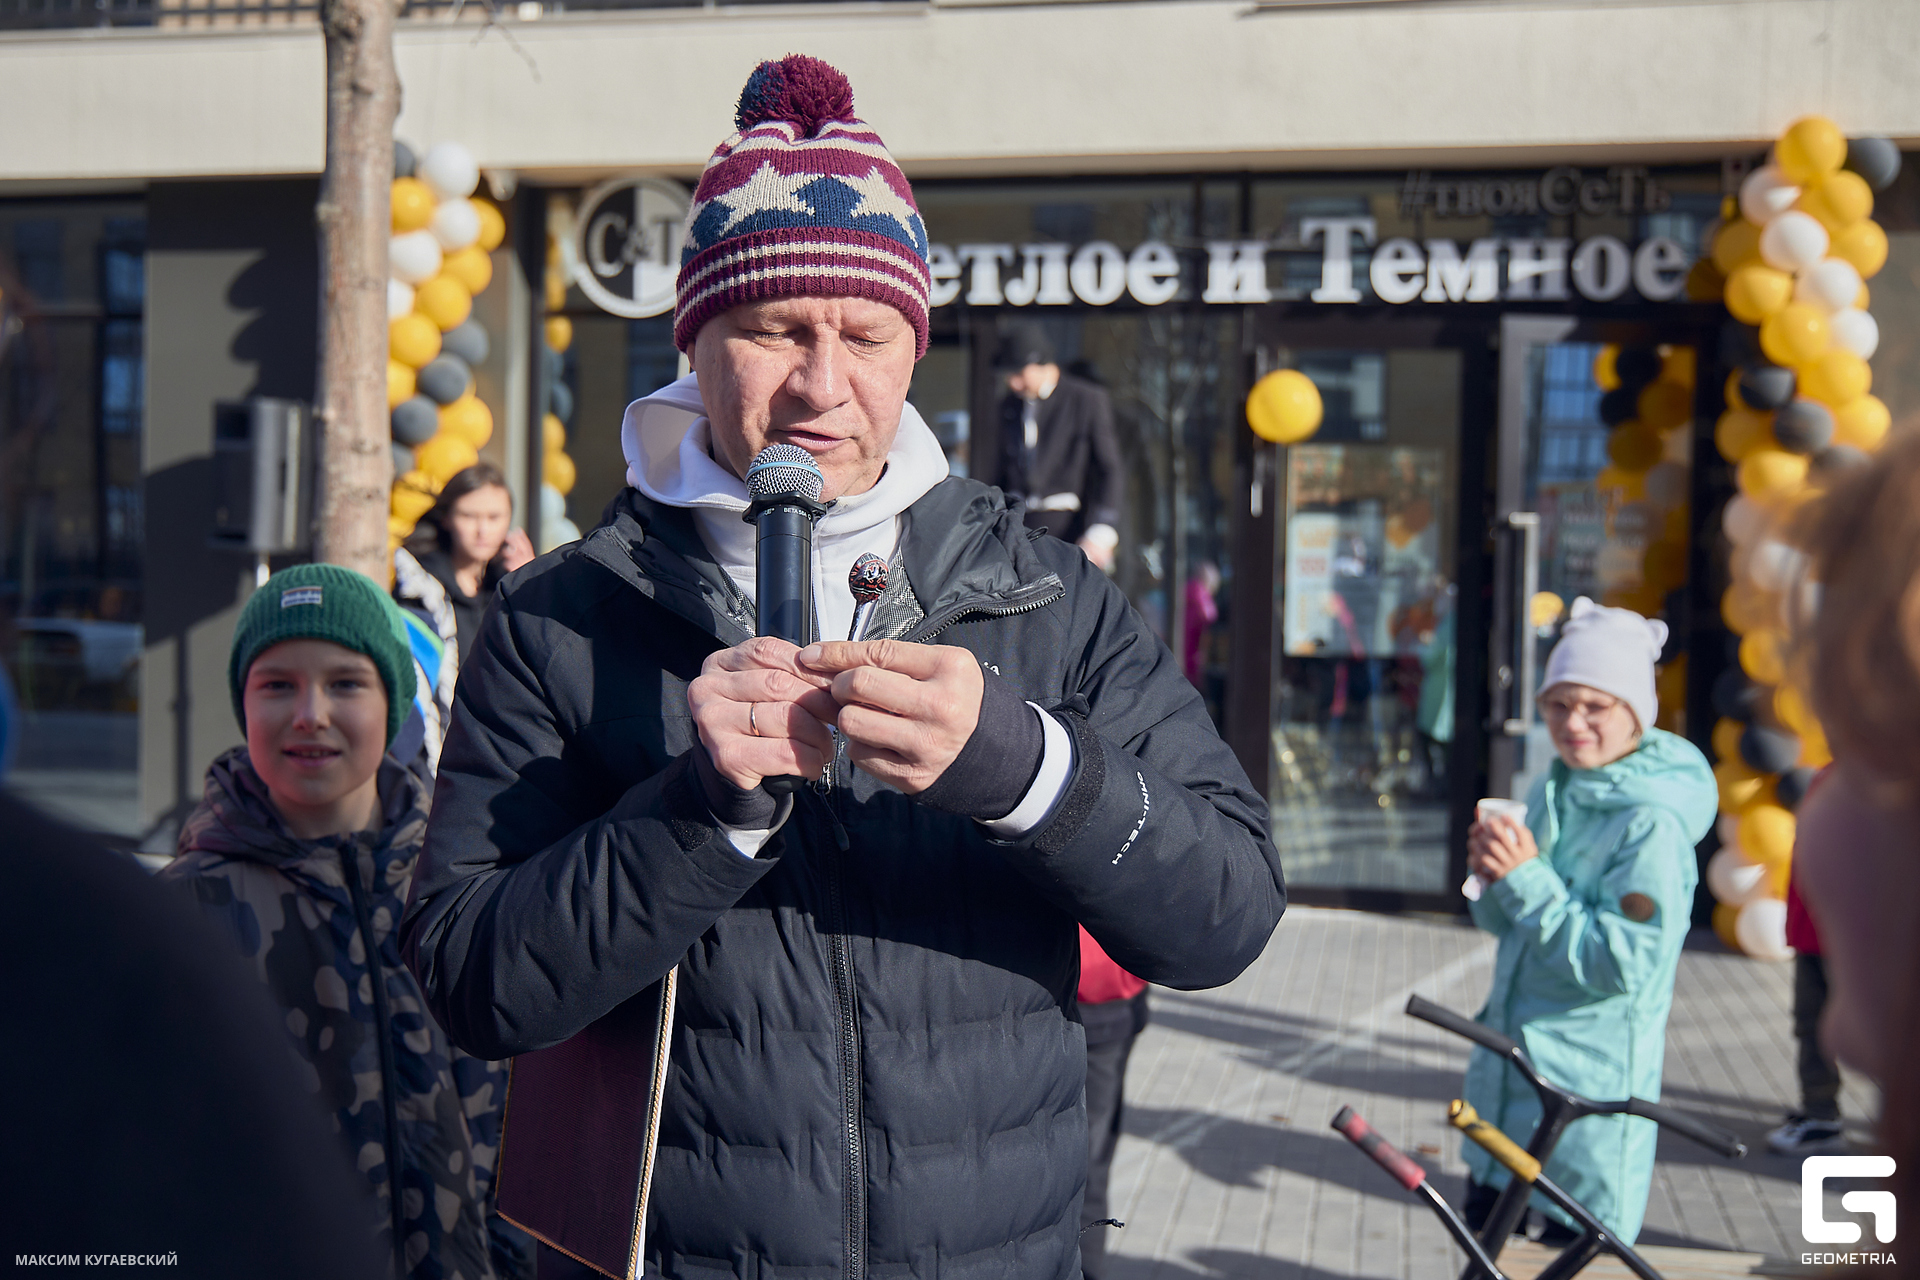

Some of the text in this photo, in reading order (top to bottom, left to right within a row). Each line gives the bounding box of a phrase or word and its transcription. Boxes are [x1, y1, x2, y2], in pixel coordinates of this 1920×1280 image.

[1202, 240, 1273, 304] и
[1299, 216, 1687, 305] Темное
[1111, 771, 1150, 865] OMNI-TECH
